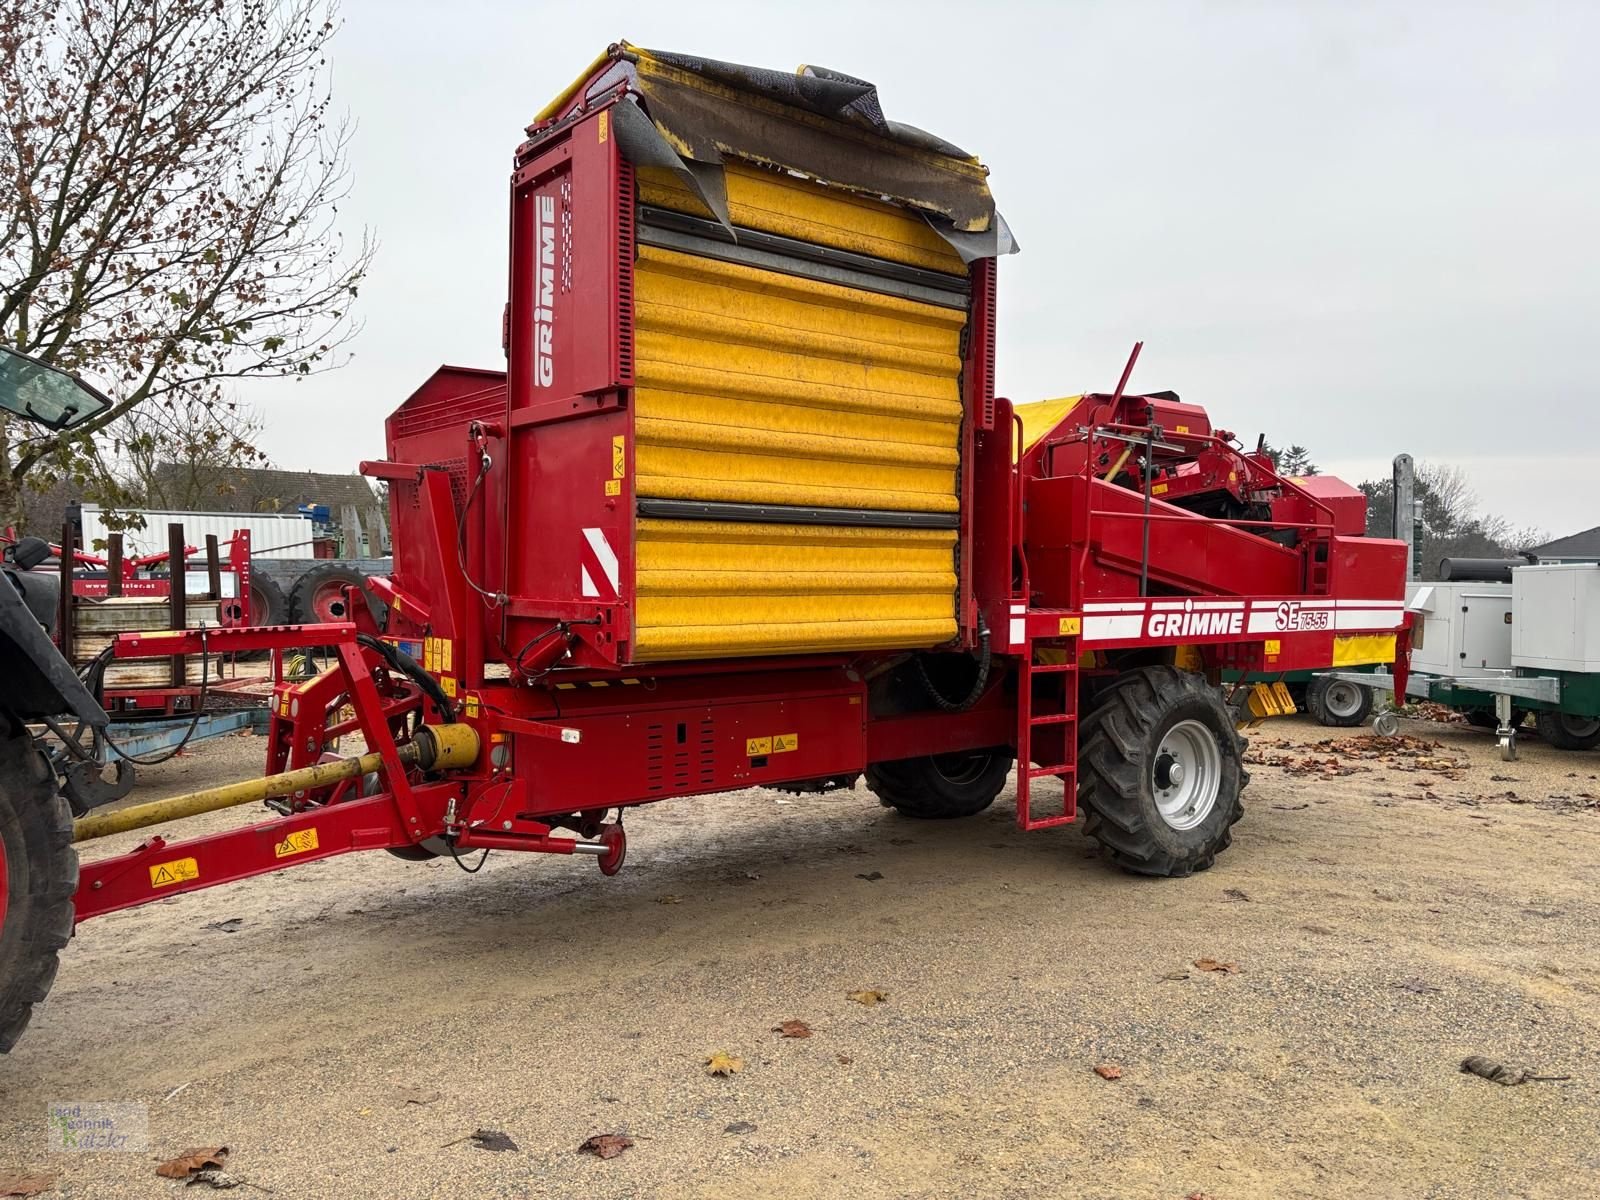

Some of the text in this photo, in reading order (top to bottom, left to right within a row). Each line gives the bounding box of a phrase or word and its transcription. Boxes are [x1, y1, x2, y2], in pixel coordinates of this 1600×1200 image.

[534, 196, 555, 388] GRIMME
[1148, 599, 1244, 637] GRIMME
[1275, 602, 1328, 630] SE 75-55
